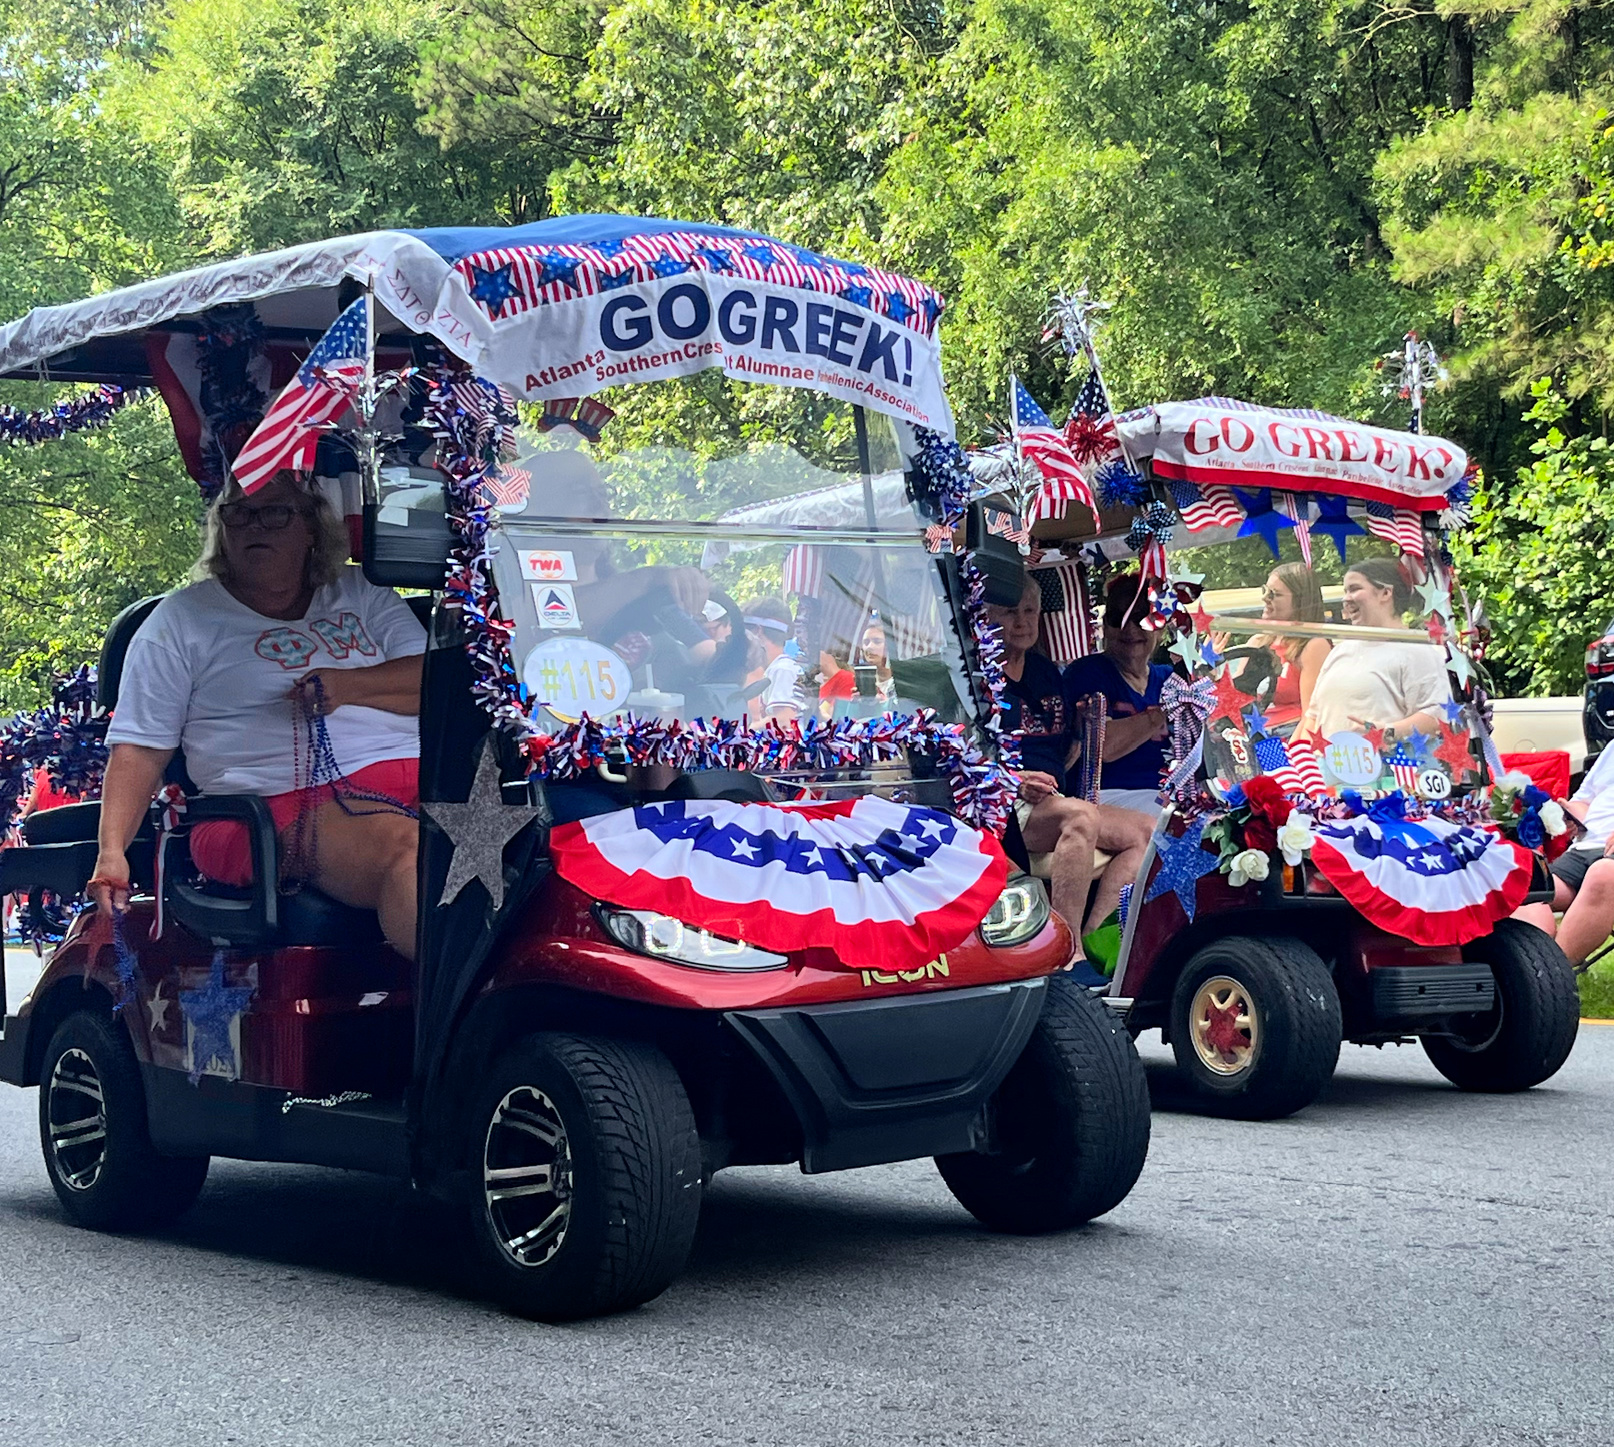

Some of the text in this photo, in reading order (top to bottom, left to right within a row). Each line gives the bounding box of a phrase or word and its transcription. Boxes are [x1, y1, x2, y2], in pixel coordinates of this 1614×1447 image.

[525, 349, 606, 392] Atlanta
[596, 349, 683, 381] Southern
[735, 356, 815, 381] Alumnae
[864, 382, 930, 423] Association
[1184, 417, 1453, 480] GO GREEK!
[530, 559, 563, 571] TWA
[540, 659, 616, 700] #115
[1332, 745, 1373, 774] #115
[1426, 775, 1445, 793] SGI
